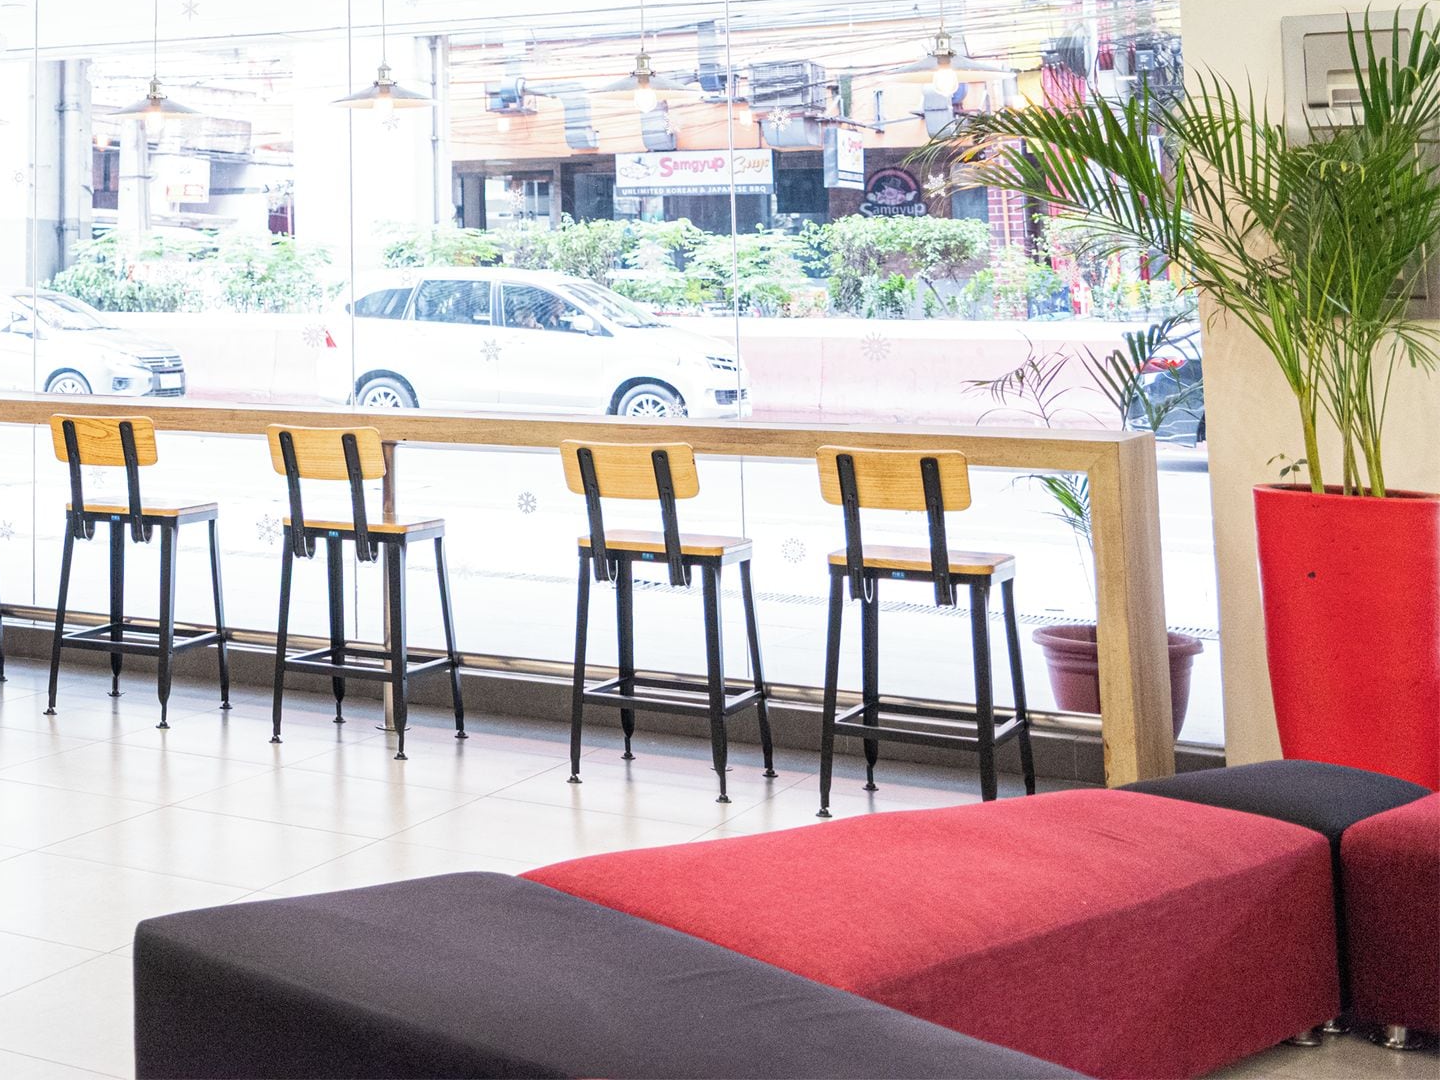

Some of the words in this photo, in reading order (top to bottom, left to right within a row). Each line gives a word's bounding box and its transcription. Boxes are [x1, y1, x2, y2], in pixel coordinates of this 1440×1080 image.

[659, 156, 725, 177] Samgyup
[622, 188, 664, 196] UNLIMITED
[666, 187, 698, 195] KOREAN
[749, 185, 767, 194] BBQ
